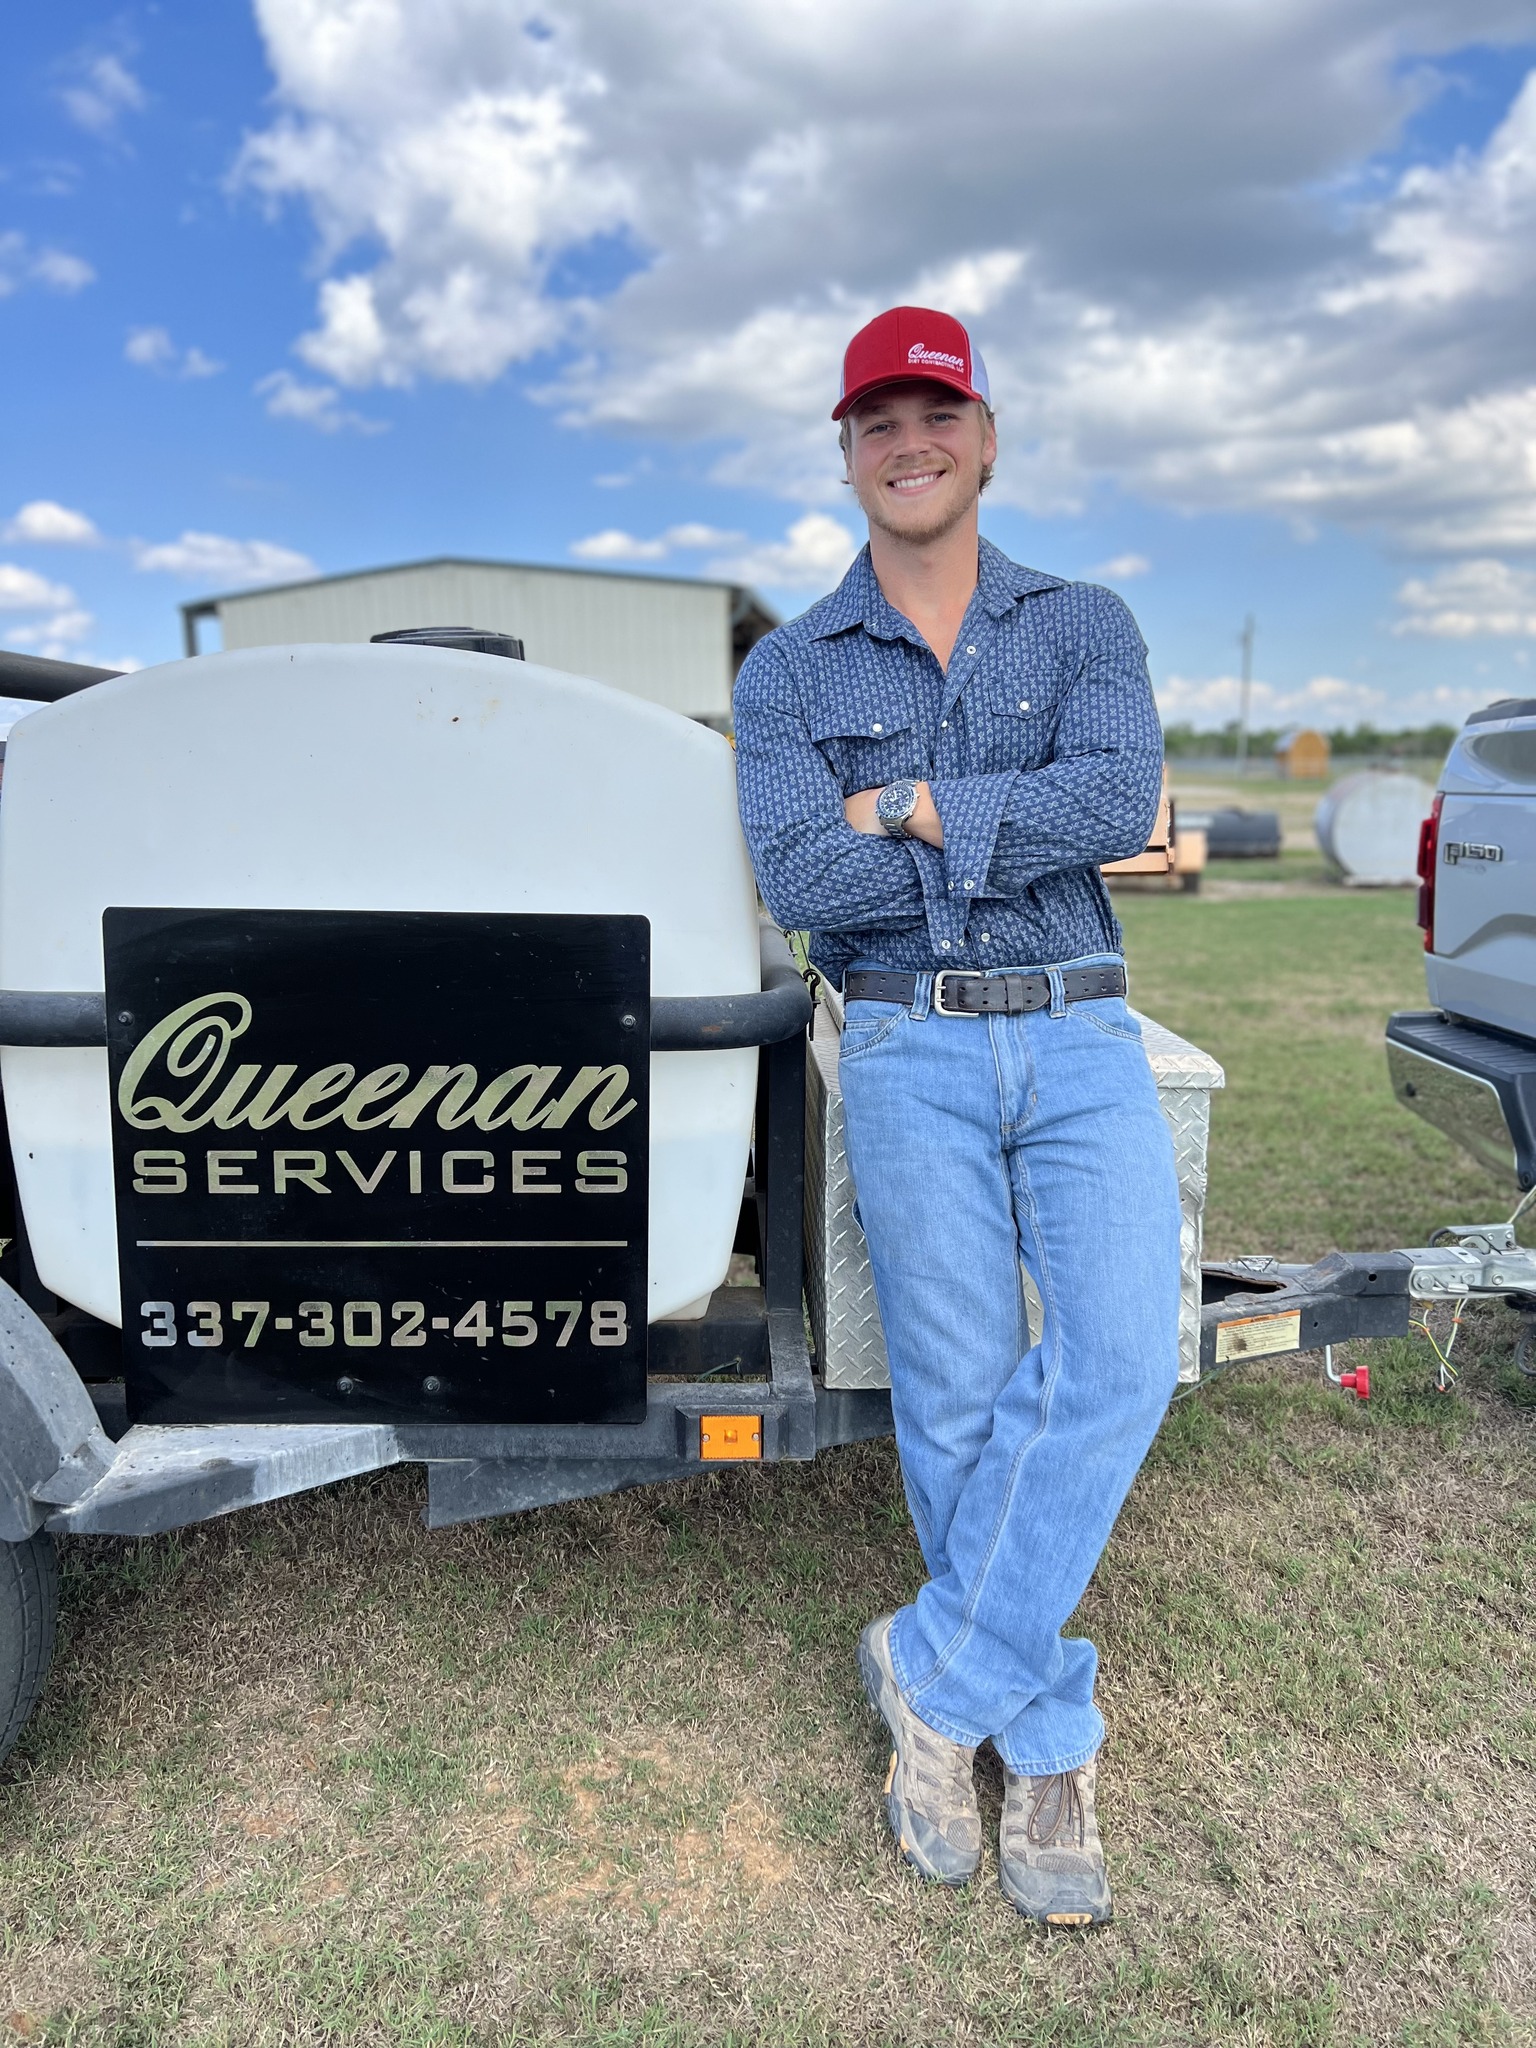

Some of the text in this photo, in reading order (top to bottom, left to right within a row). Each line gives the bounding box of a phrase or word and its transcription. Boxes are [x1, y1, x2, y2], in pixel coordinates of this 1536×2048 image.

[907, 342, 964, 367] Queenan
[118, 992, 638, 1133] Queenan
[132, 1150, 628, 1194] SERVICES
[140, 1301, 628, 1348] 337-302-4578
